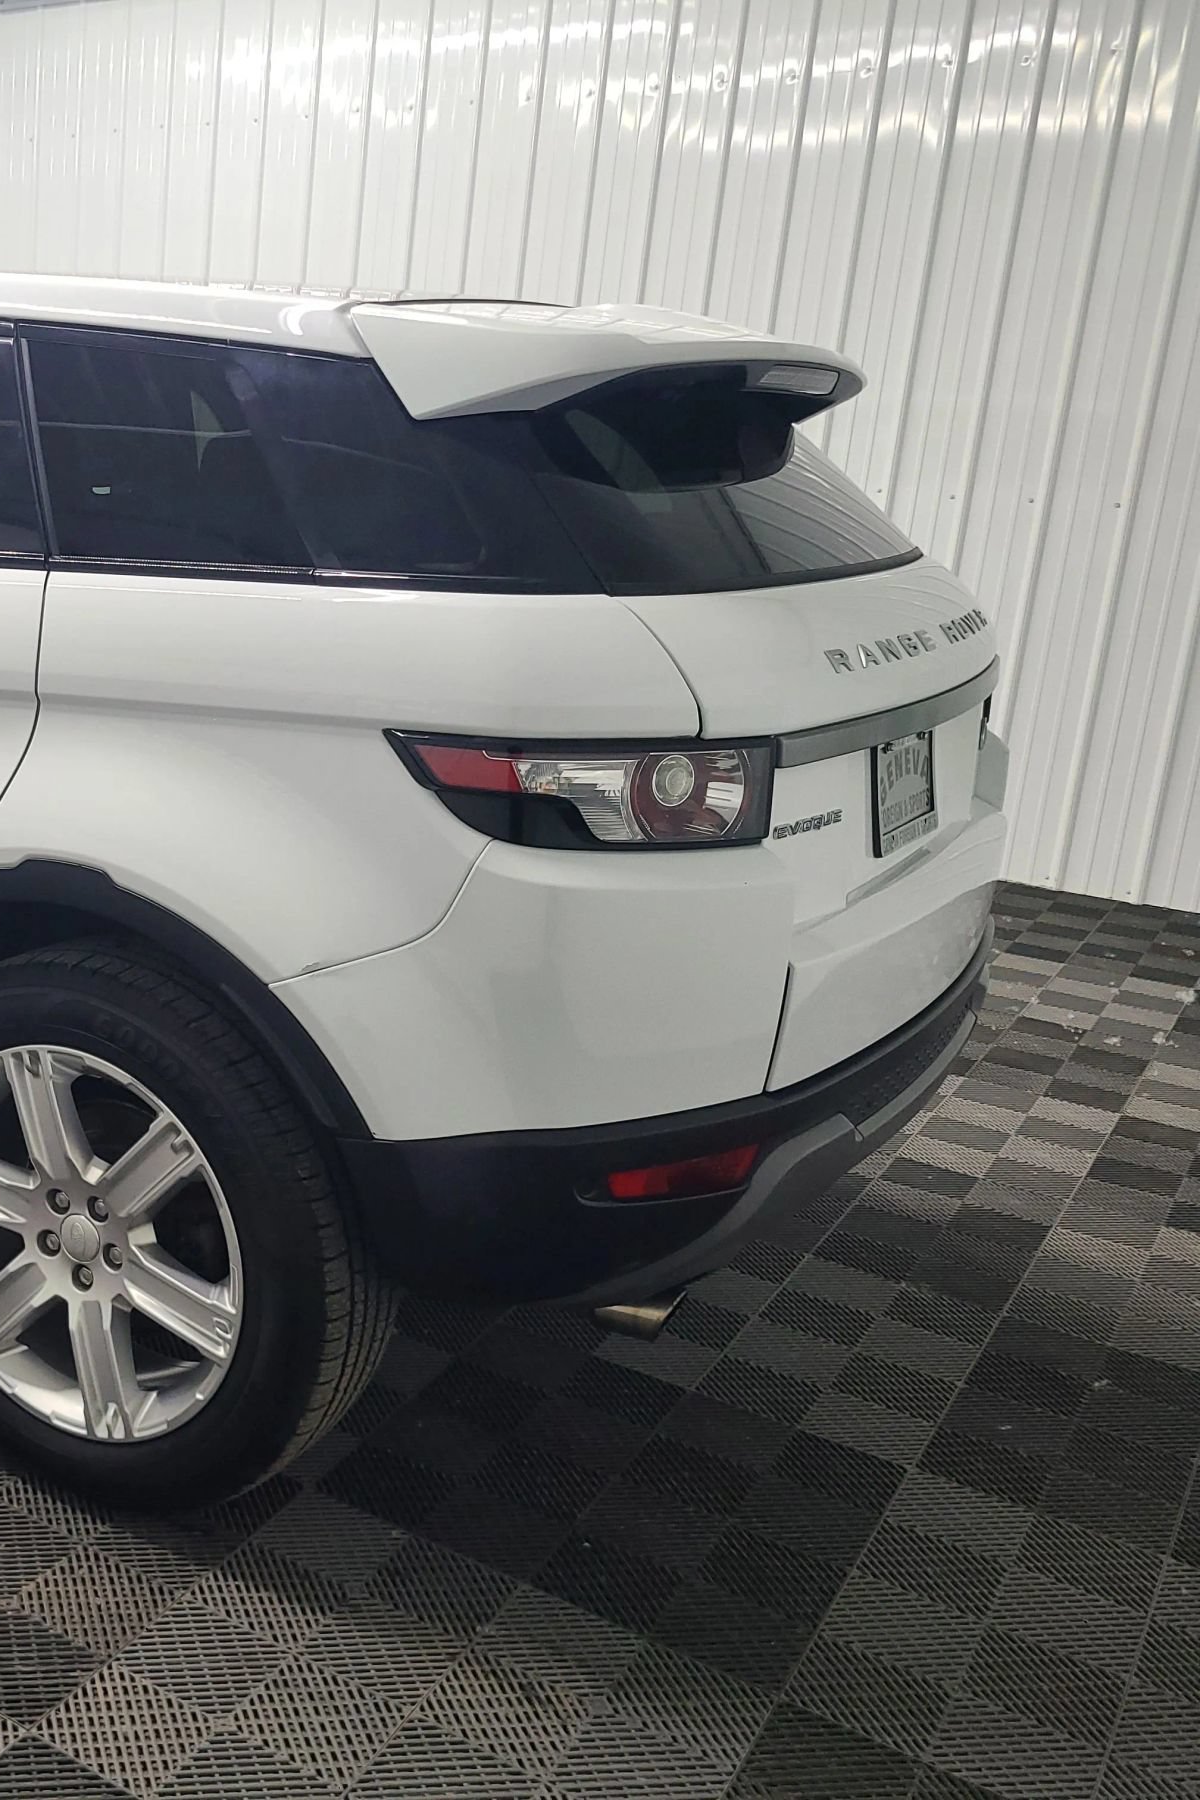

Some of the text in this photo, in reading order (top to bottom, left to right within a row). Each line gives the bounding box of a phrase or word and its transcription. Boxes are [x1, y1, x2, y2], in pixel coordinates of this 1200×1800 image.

[824, 629, 936, 673] RANGE
[880, 746, 929, 807] GENEVA
[773, 809, 843, 840] EVOQUE
